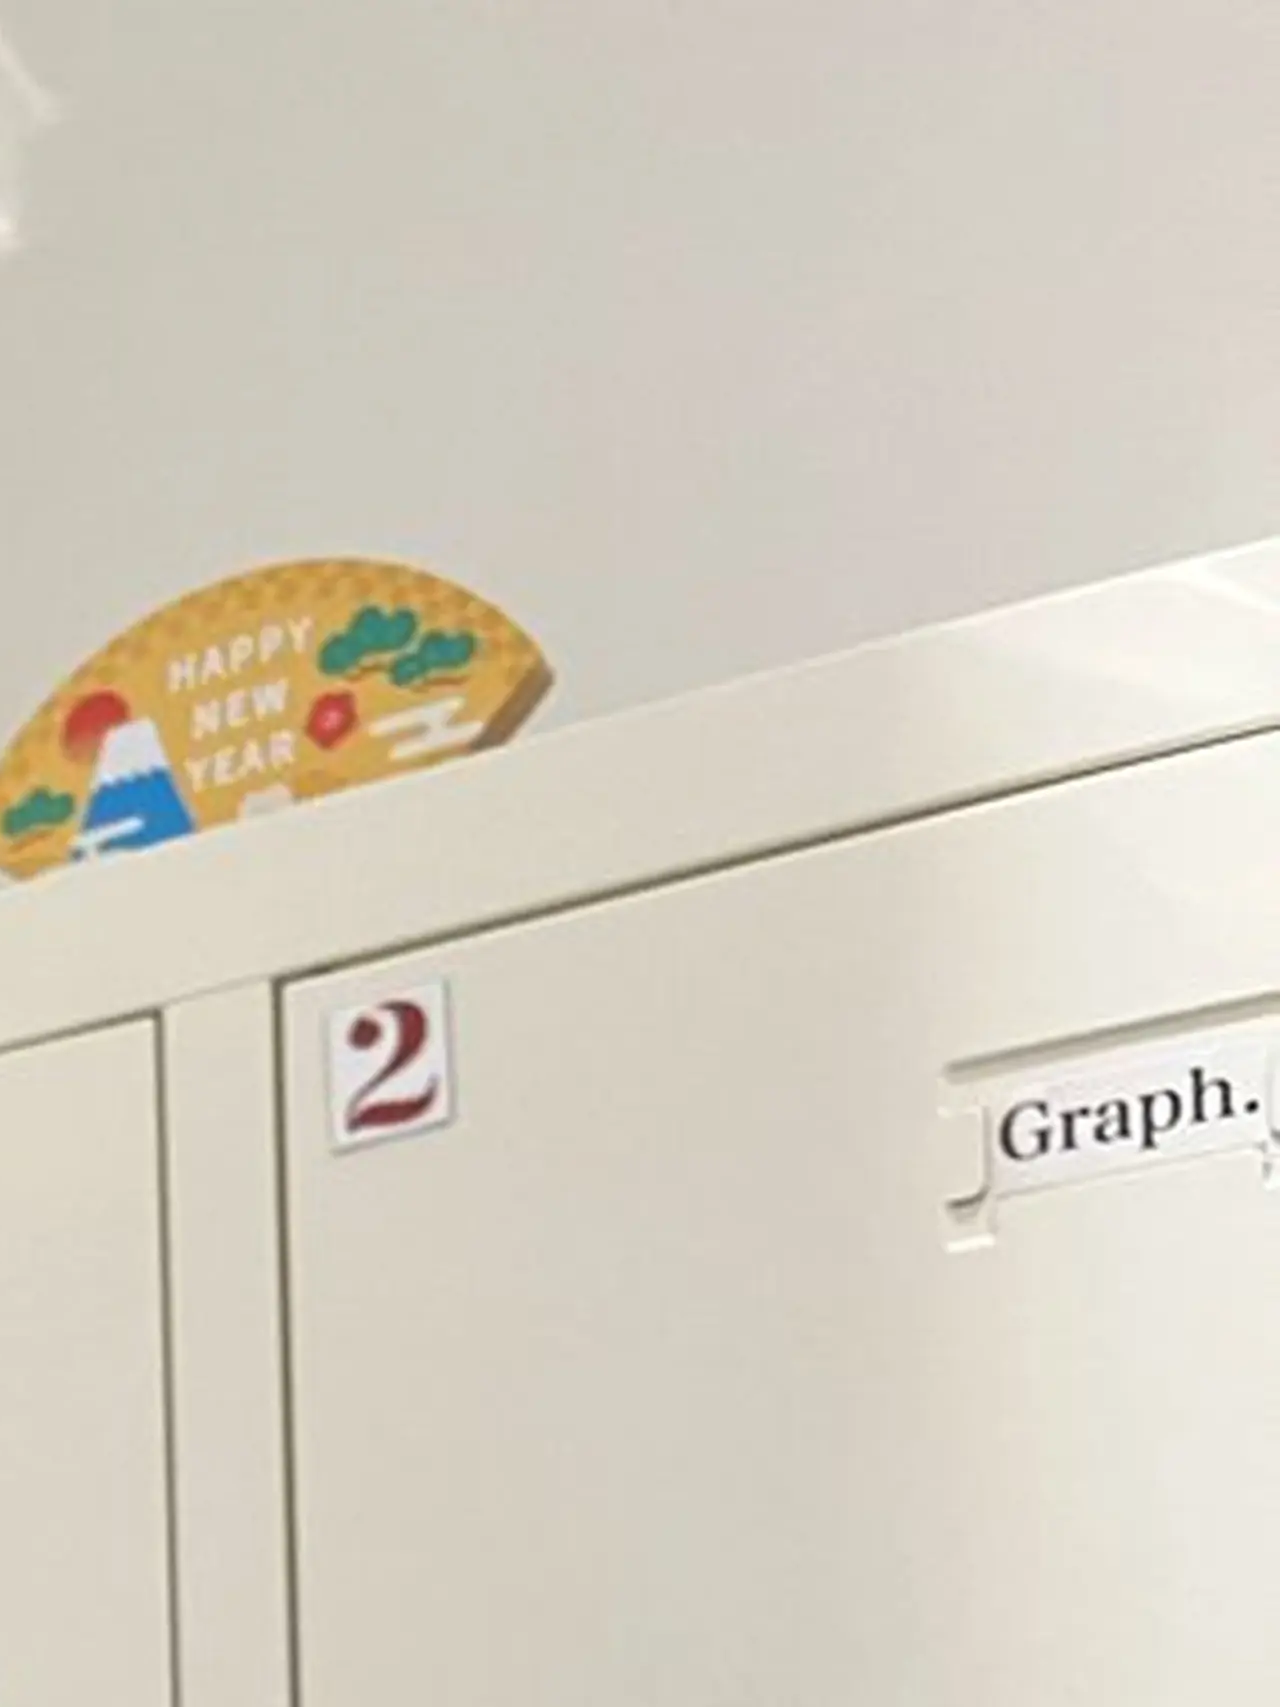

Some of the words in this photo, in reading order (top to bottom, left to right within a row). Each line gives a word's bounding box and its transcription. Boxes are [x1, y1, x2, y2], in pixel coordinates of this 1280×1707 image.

[166, 616, 316, 694] HAPPY
[192, 678, 290, 739] NEW
[183, 731, 297, 792] YEAR
[347, 999, 440, 1134] 2
[999, 1065, 1260, 1162] Graph.
